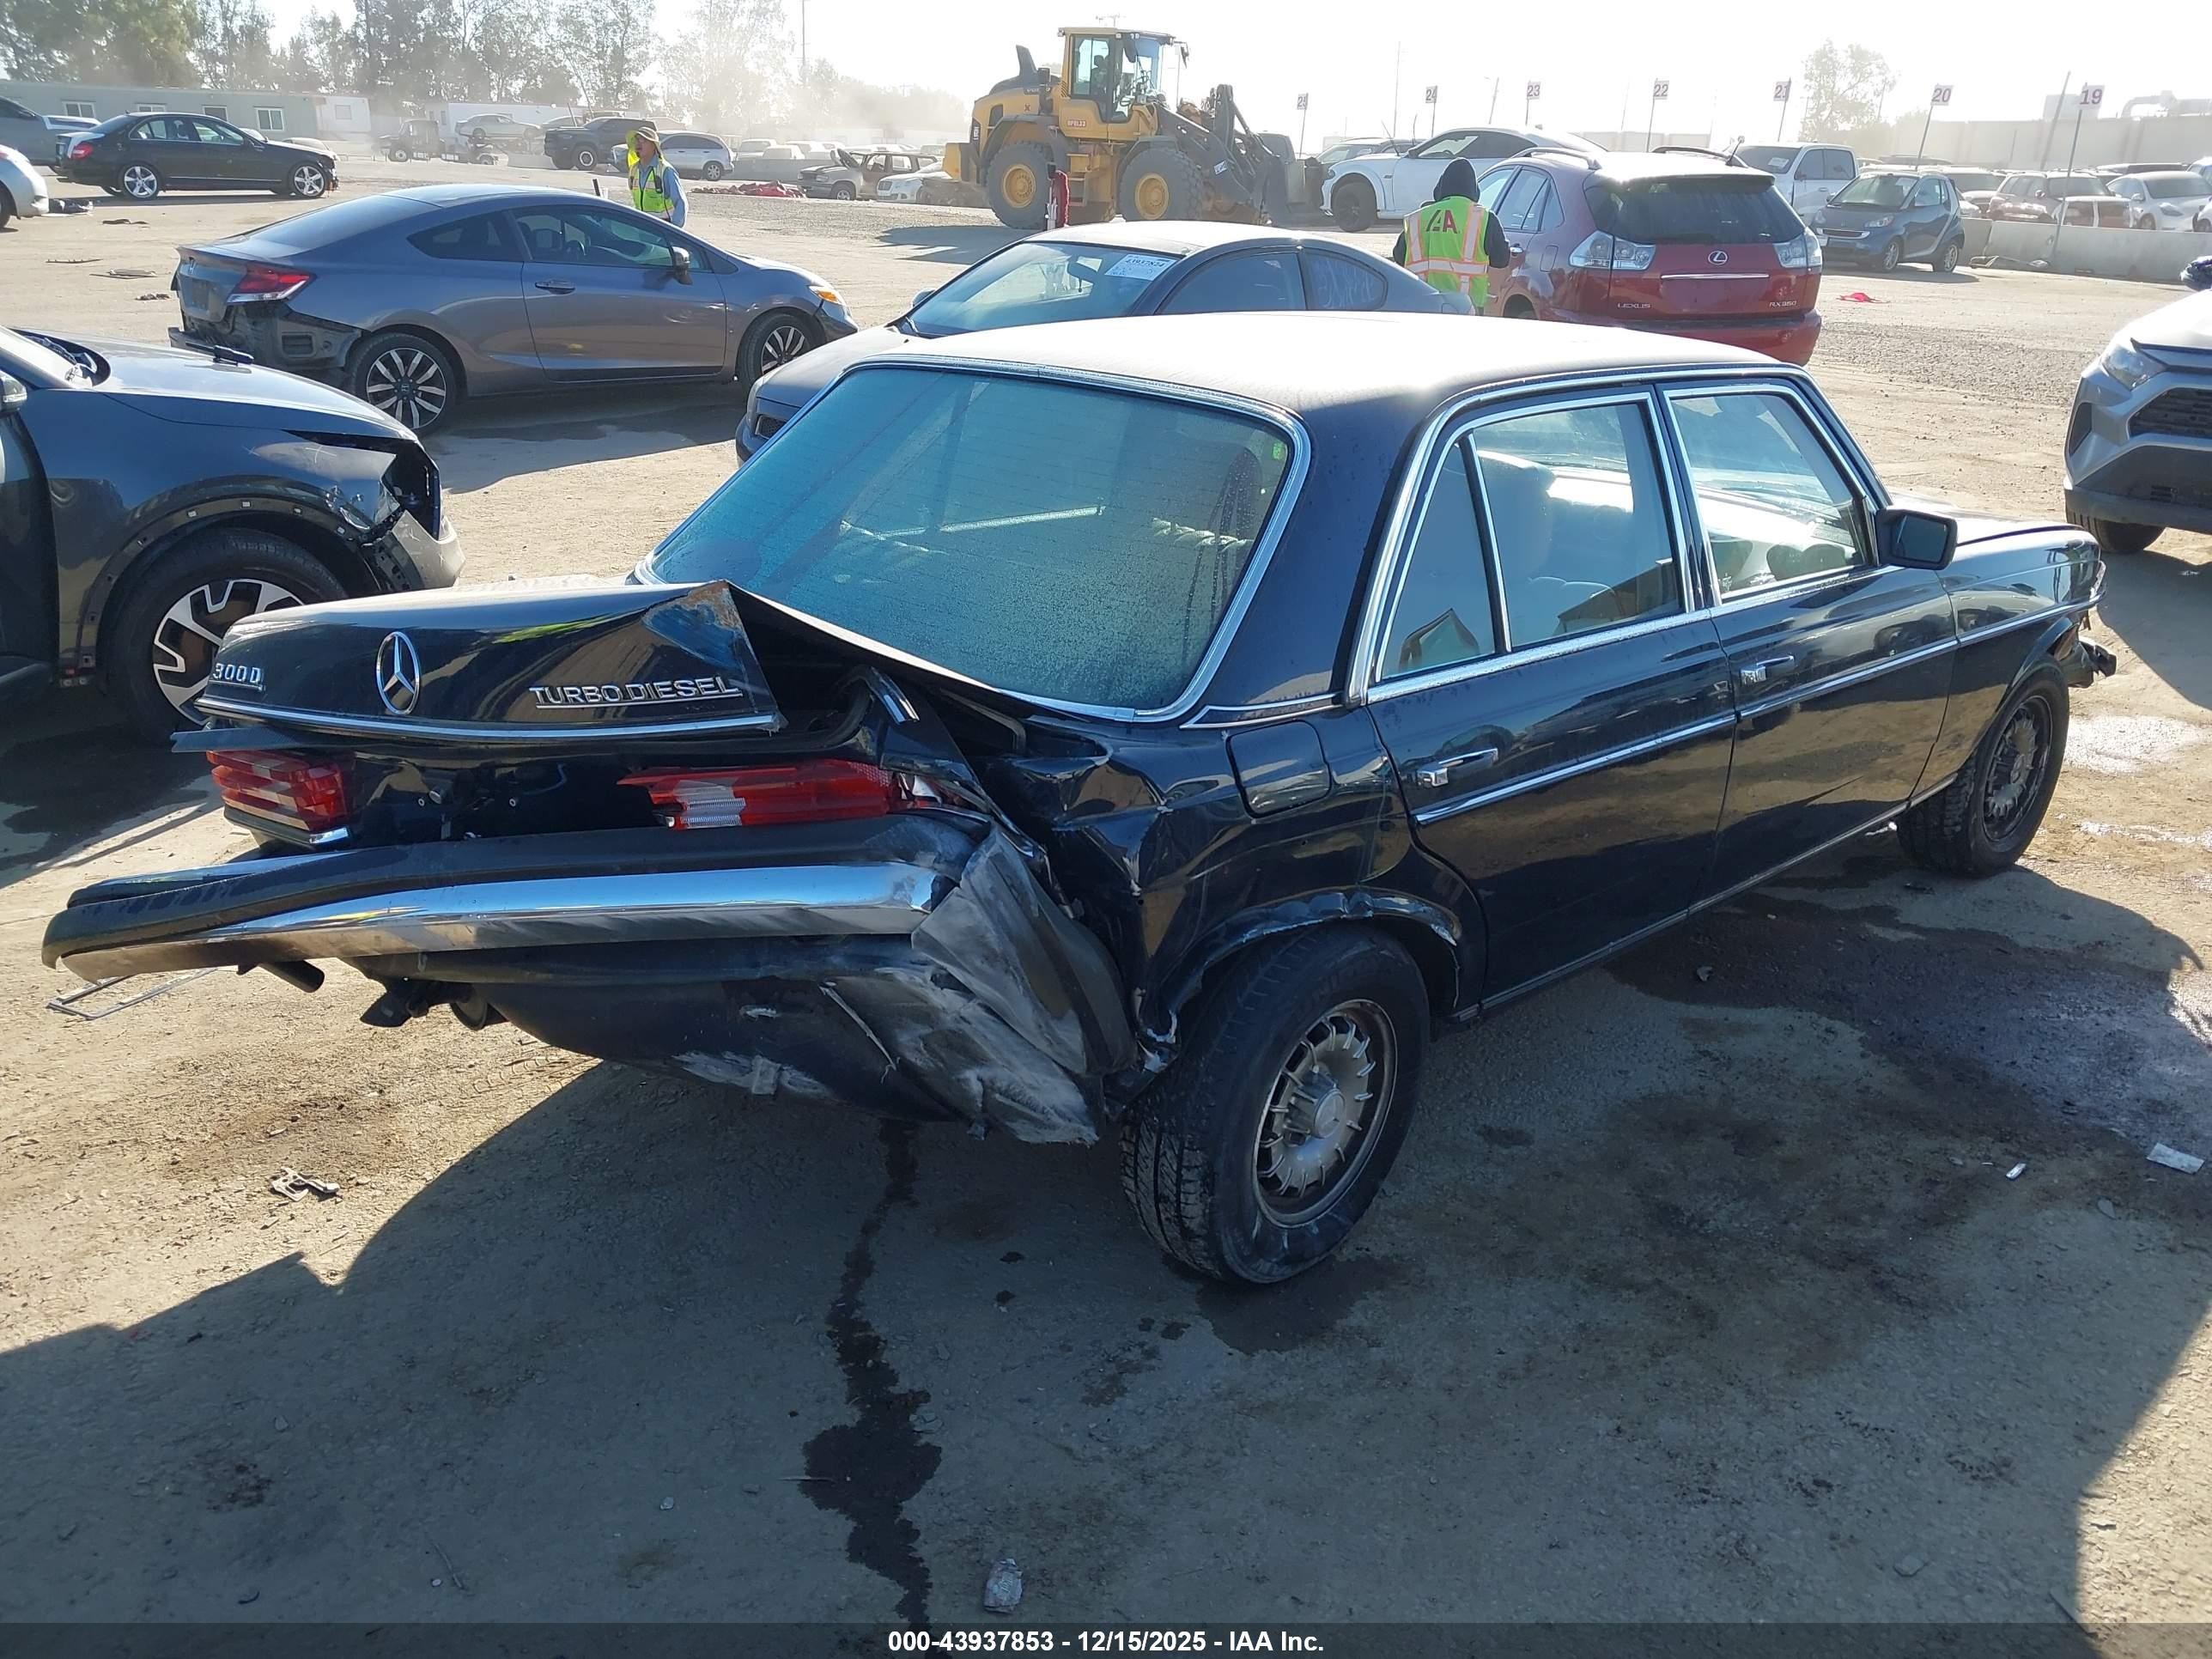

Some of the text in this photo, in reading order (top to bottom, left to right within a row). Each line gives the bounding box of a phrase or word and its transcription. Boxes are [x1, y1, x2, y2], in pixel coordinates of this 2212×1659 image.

[1425, 88, 1437, 101] 24
[1527, 84, 1540, 97] 23
[1653, 83, 1668, 97] 22
[1773, 84, 1788, 99] 21
[1931, 88, 1951, 103] 20
[2079, 88, 2103, 105] 19
[529, 676, 739, 705] TURBO DIESEL
